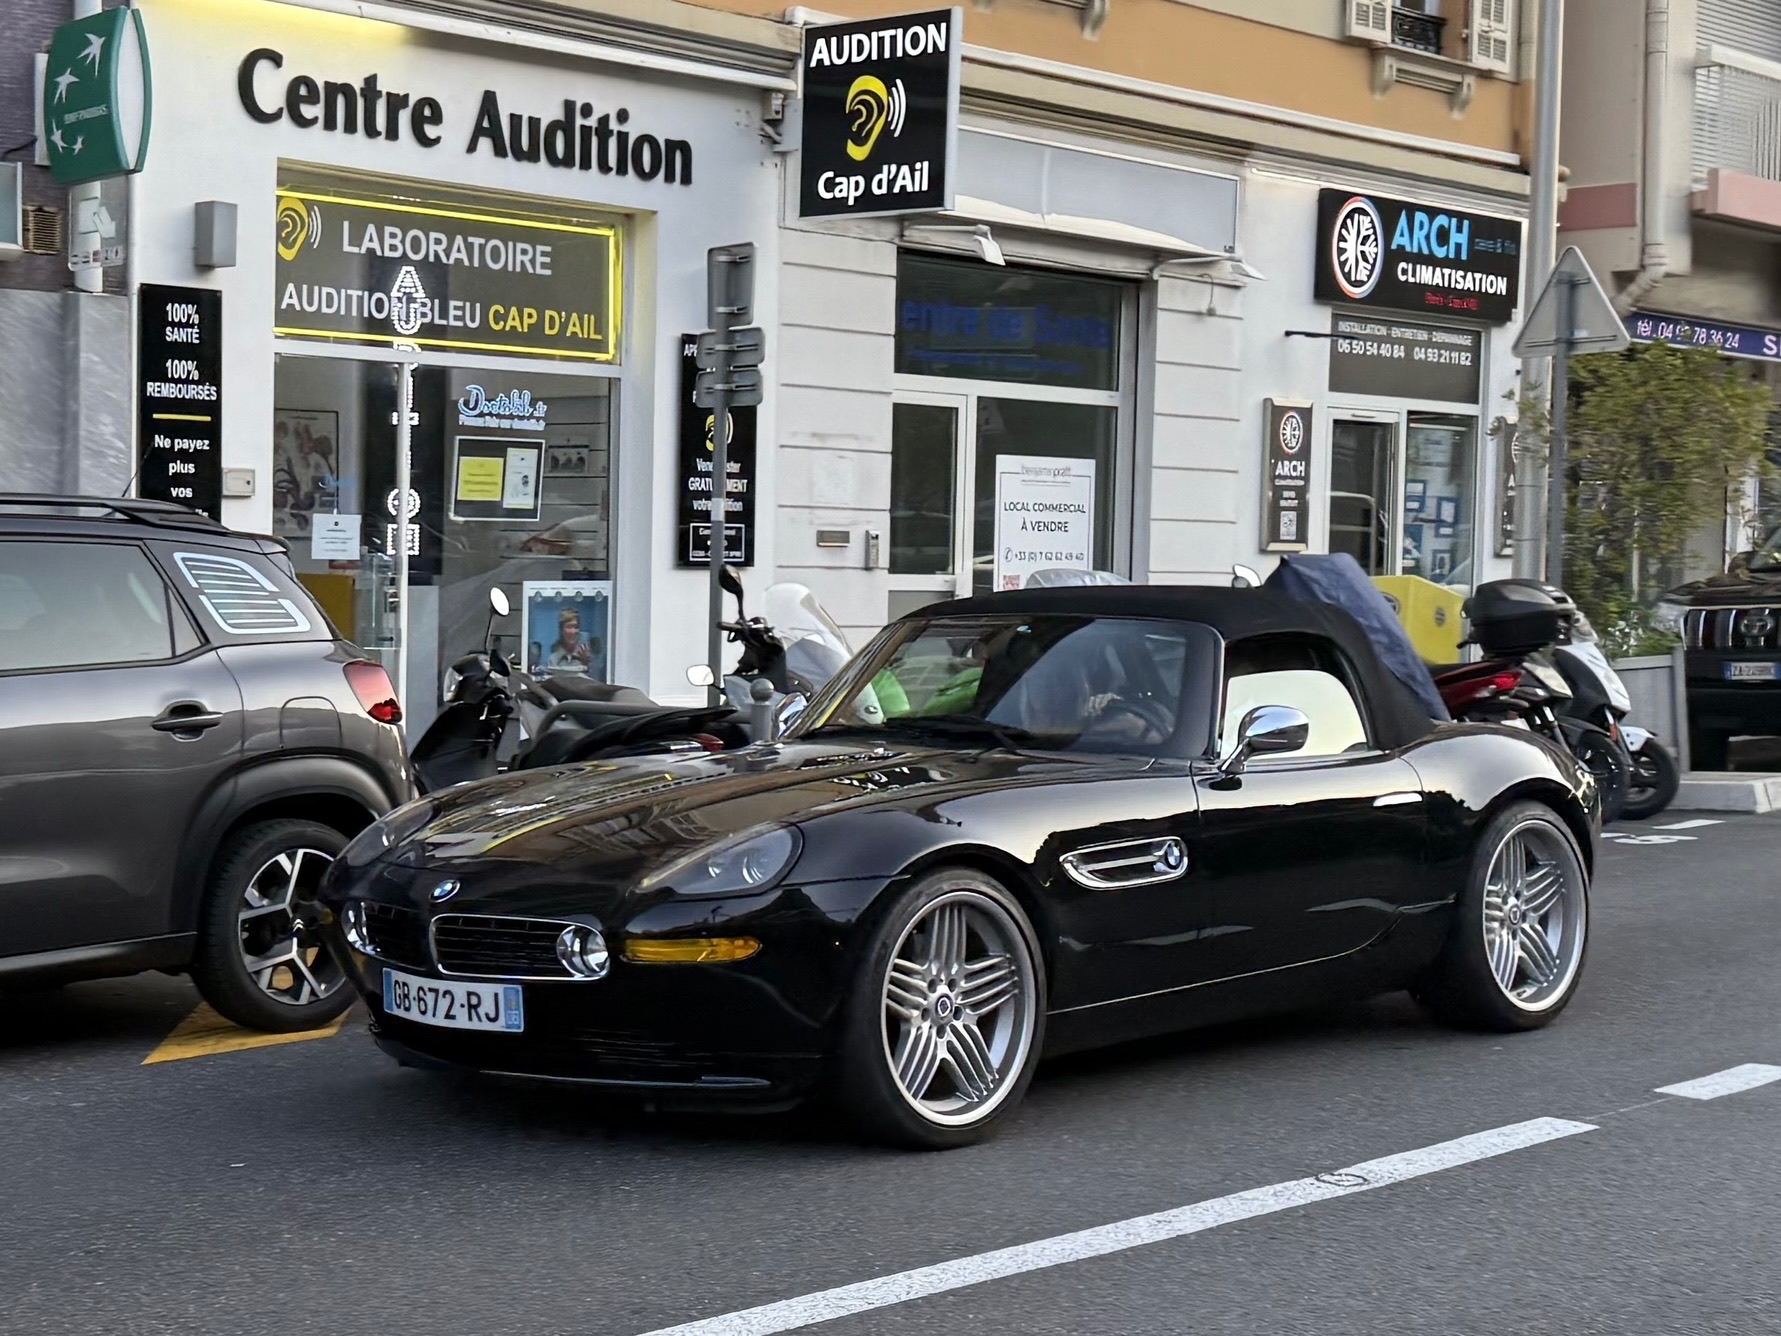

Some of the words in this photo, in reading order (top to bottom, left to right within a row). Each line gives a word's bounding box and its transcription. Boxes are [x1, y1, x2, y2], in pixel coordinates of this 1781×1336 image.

[810, 22, 947, 68] AUDITION
[237, 47, 443, 149] Centre
[466, 89, 693, 187] Audition
[817, 170, 865, 206] Cap
[871, 160, 929, 196] d'Ail
[1390, 209, 1470, 261] ARCH
[342, 220, 553, 276] LABORATOIRE
[1397, 261, 1508, 296] CLIMATISATION
[165, 302, 200, 325] 100%
[488, 304, 538, 333] CAP
[544, 309, 603, 340] D'AIL
[165, 325, 200, 344] SANTÉ
[1337, 320, 1388, 337] INSTALLATION
[1692, 326, 1707, 345] 78
[1725, 333, 1740, 349] 24
[1337, 340, 1351, 353] 06
[1352, 341, 1365, 355] 50
[1366, 342, 1378, 356] 54
[1379, 343, 1392, 357] 40
[1392, 345, 1405, 359] 84
[1413, 346, 1426, 360] 04
[1427, 348, 1439, 362] 93
[1439, 349, 1450, 364] 21
[1450, 351, 1459, 365] 11
[1460, 352, 1472, 366] 82
[165, 358, 200, 381] 100%
[146, 381, 218, 401] REMBOURSÉS
[154, 434, 171, 449] Ne
[174, 437, 211, 452] payez
[168, 460, 196, 477] plus
[1275, 460, 1306, 477] ARCH
[170, 486, 193, 498] vos
[1003, 501, 1031, 513] LOCAL
[1032, 502, 1087, 514] COMMERCIAL
[1020, 517, 1028, 532] À
[1030, 520, 1070, 533] VENDRE
[393, 979, 500, 1023] GB-672-RJ
